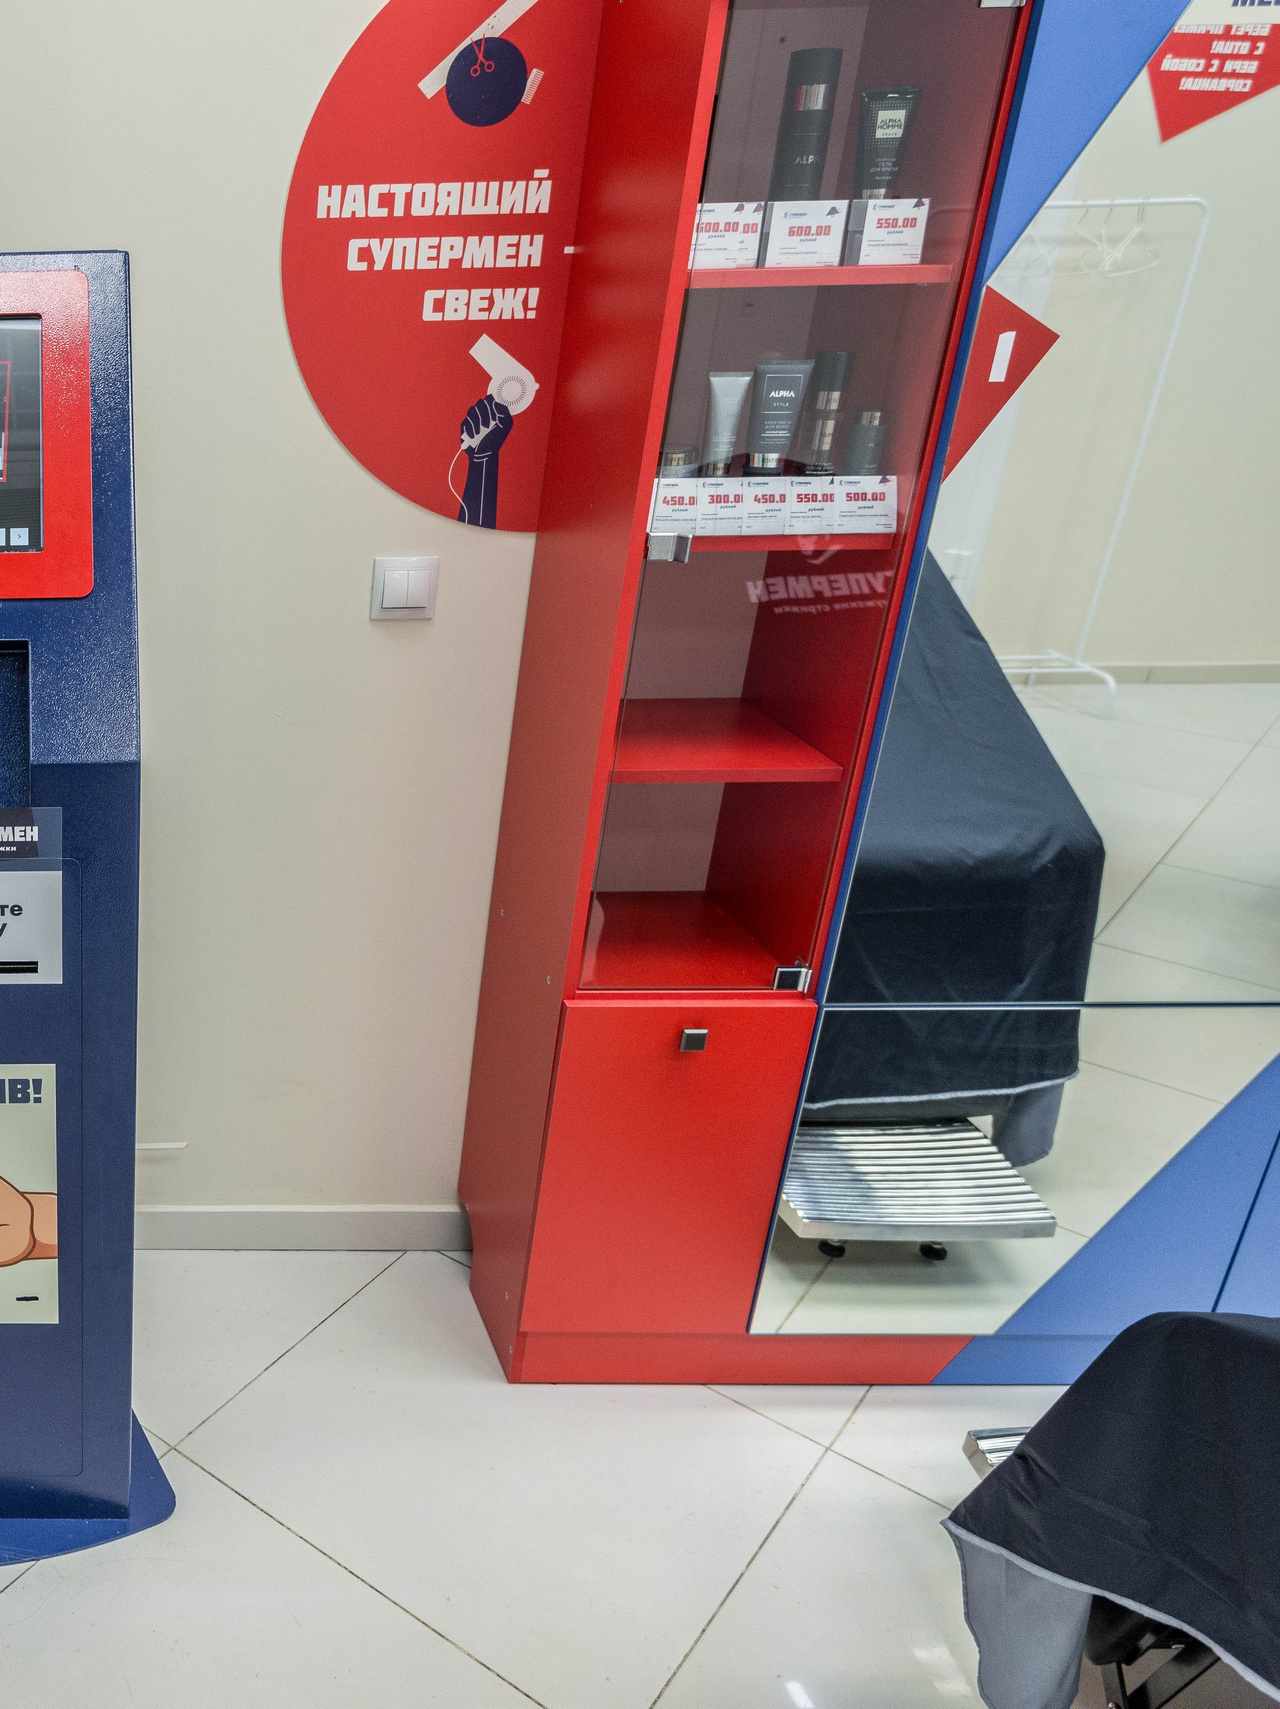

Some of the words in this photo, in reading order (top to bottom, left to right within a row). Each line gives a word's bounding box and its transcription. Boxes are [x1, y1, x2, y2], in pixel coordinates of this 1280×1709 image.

[794, 155, 815, 165] ALP
[317, 169, 552, 219] НАСТОЯЩИЙ
[876, 217, 917, 229] 550.00
[788, 225, 831, 237] 600.00
[347, 235, 544, 271] СУПЕРМЕН
[422, 288, 540, 322] СВЕЖ!
[796, 493, 835, 503] 550.00
[846, 492, 886, 502] 500.00
